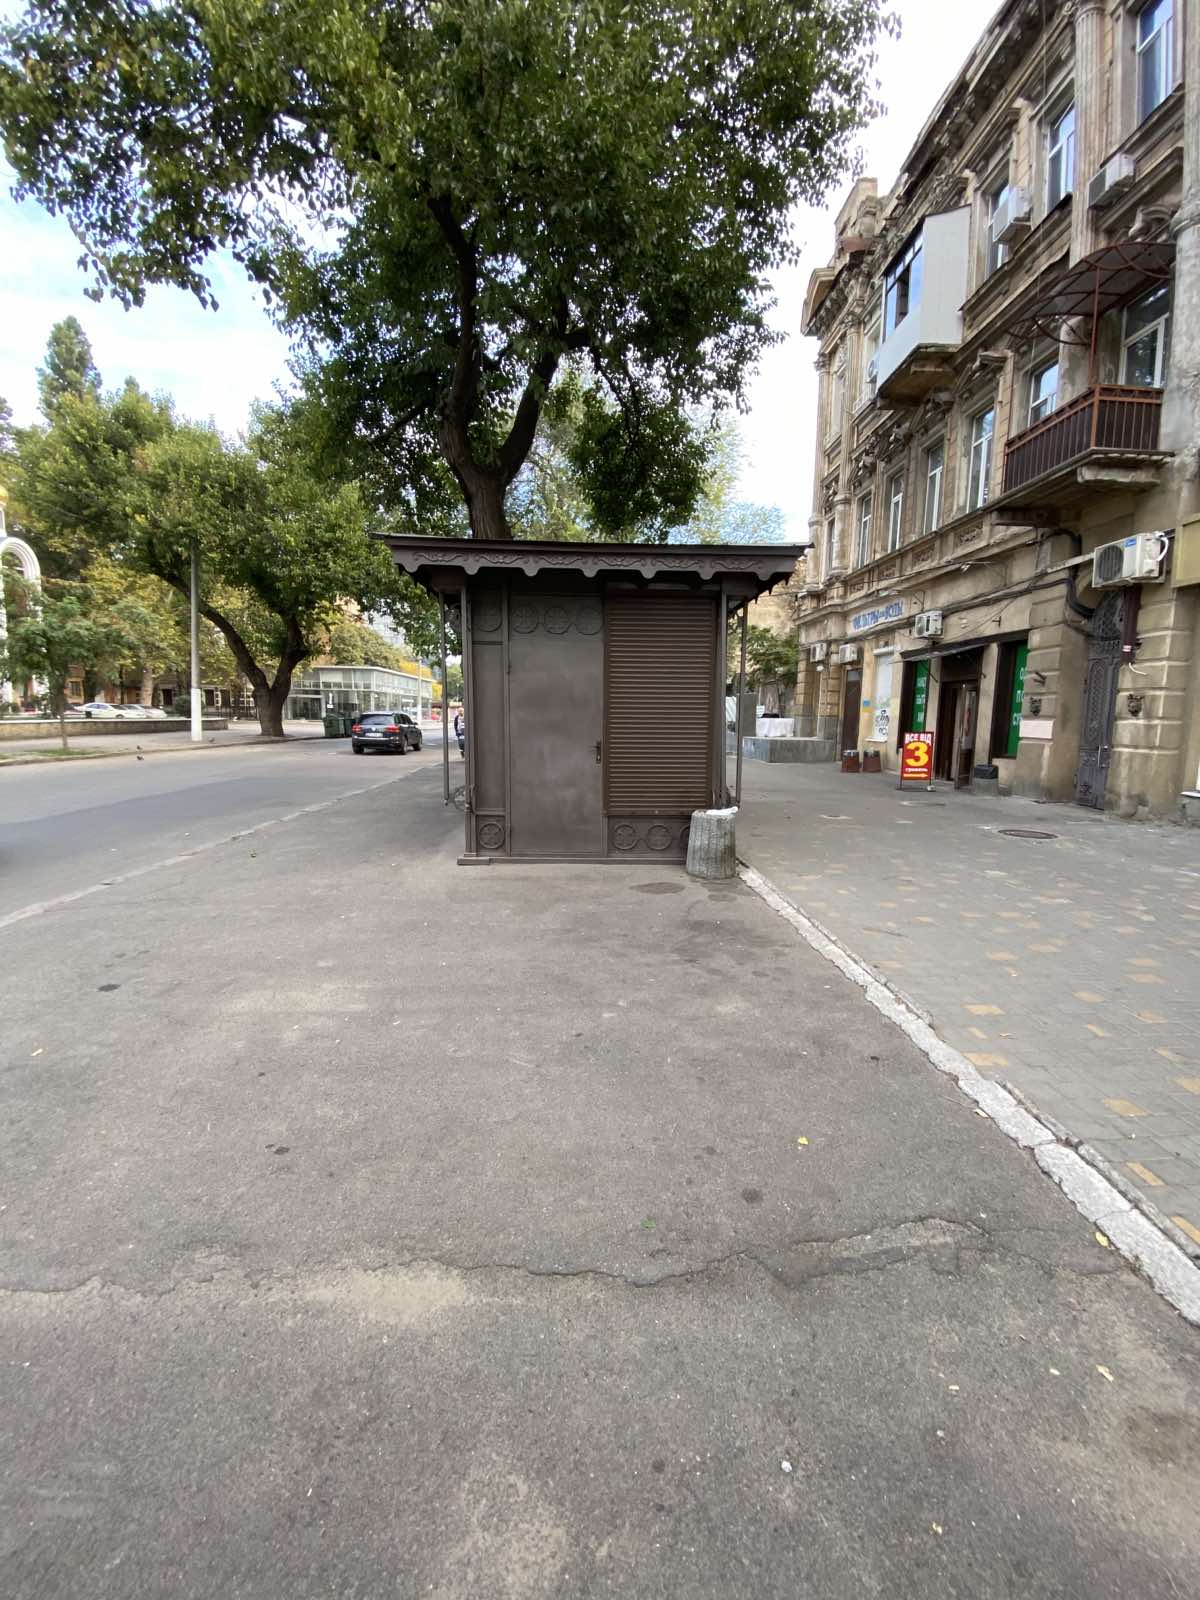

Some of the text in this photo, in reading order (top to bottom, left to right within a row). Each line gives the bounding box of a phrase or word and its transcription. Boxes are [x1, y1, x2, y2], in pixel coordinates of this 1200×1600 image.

[905, 733, 931, 746] ВСЕ ВІД
[906, 741, 929, 767] 3
